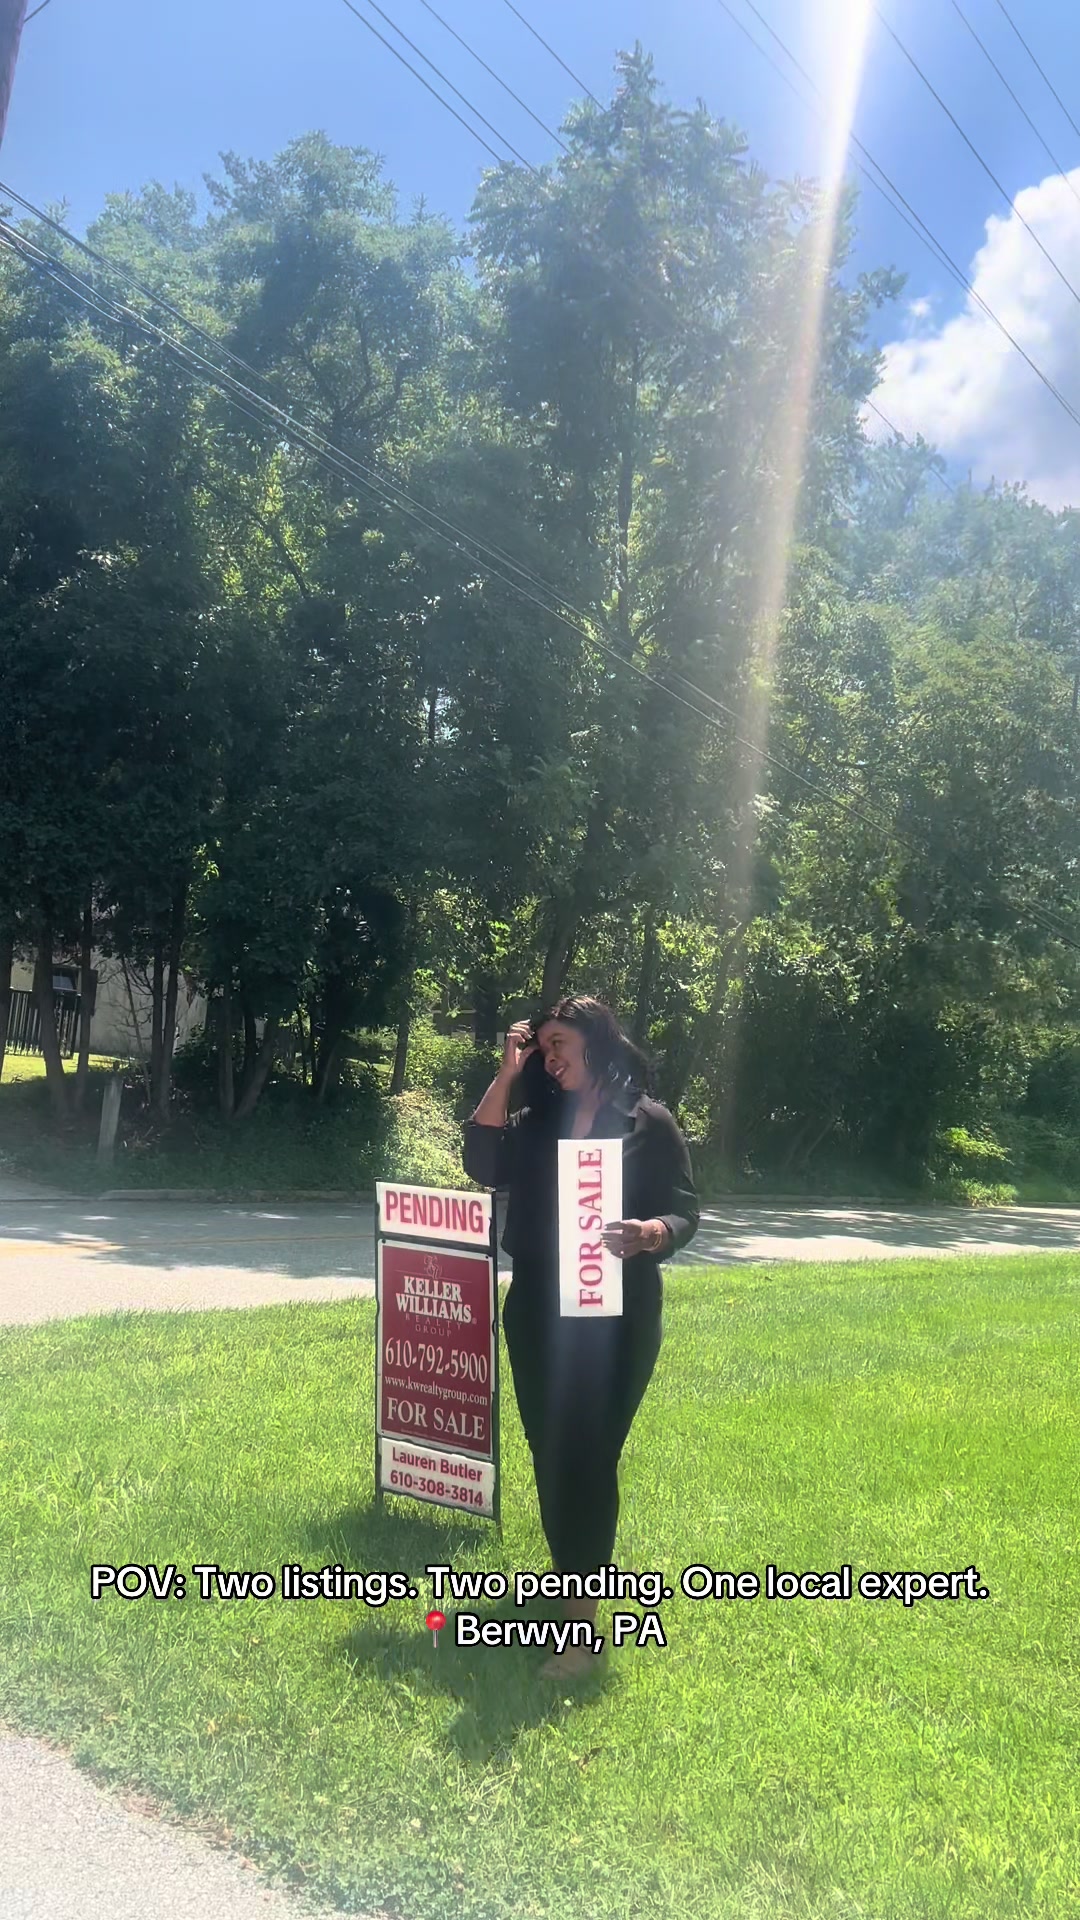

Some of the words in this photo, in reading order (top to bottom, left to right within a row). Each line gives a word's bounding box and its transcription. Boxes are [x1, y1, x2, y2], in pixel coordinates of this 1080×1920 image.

[578, 1149, 603, 1230] SALE
[385, 1190, 484, 1234] PENDING
[403, 1275, 463, 1303] KELLER
[578, 1242, 603, 1307] FOR
[405, 1312, 463, 1331] REALTY
[415, 1323, 452, 1338] GROUP
[385, 1337, 488, 1384] 610-792-5900
[384, 1375, 488, 1406] www.kwrealtygroup.com
[387, 1396, 428, 1428] FOR
[433, 1407, 486, 1441] SALE
[392, 1446, 437, 1472] Lauren
[440, 1458, 483, 1482] Butler
[390, 1469, 484, 1507] 610-308-3814
